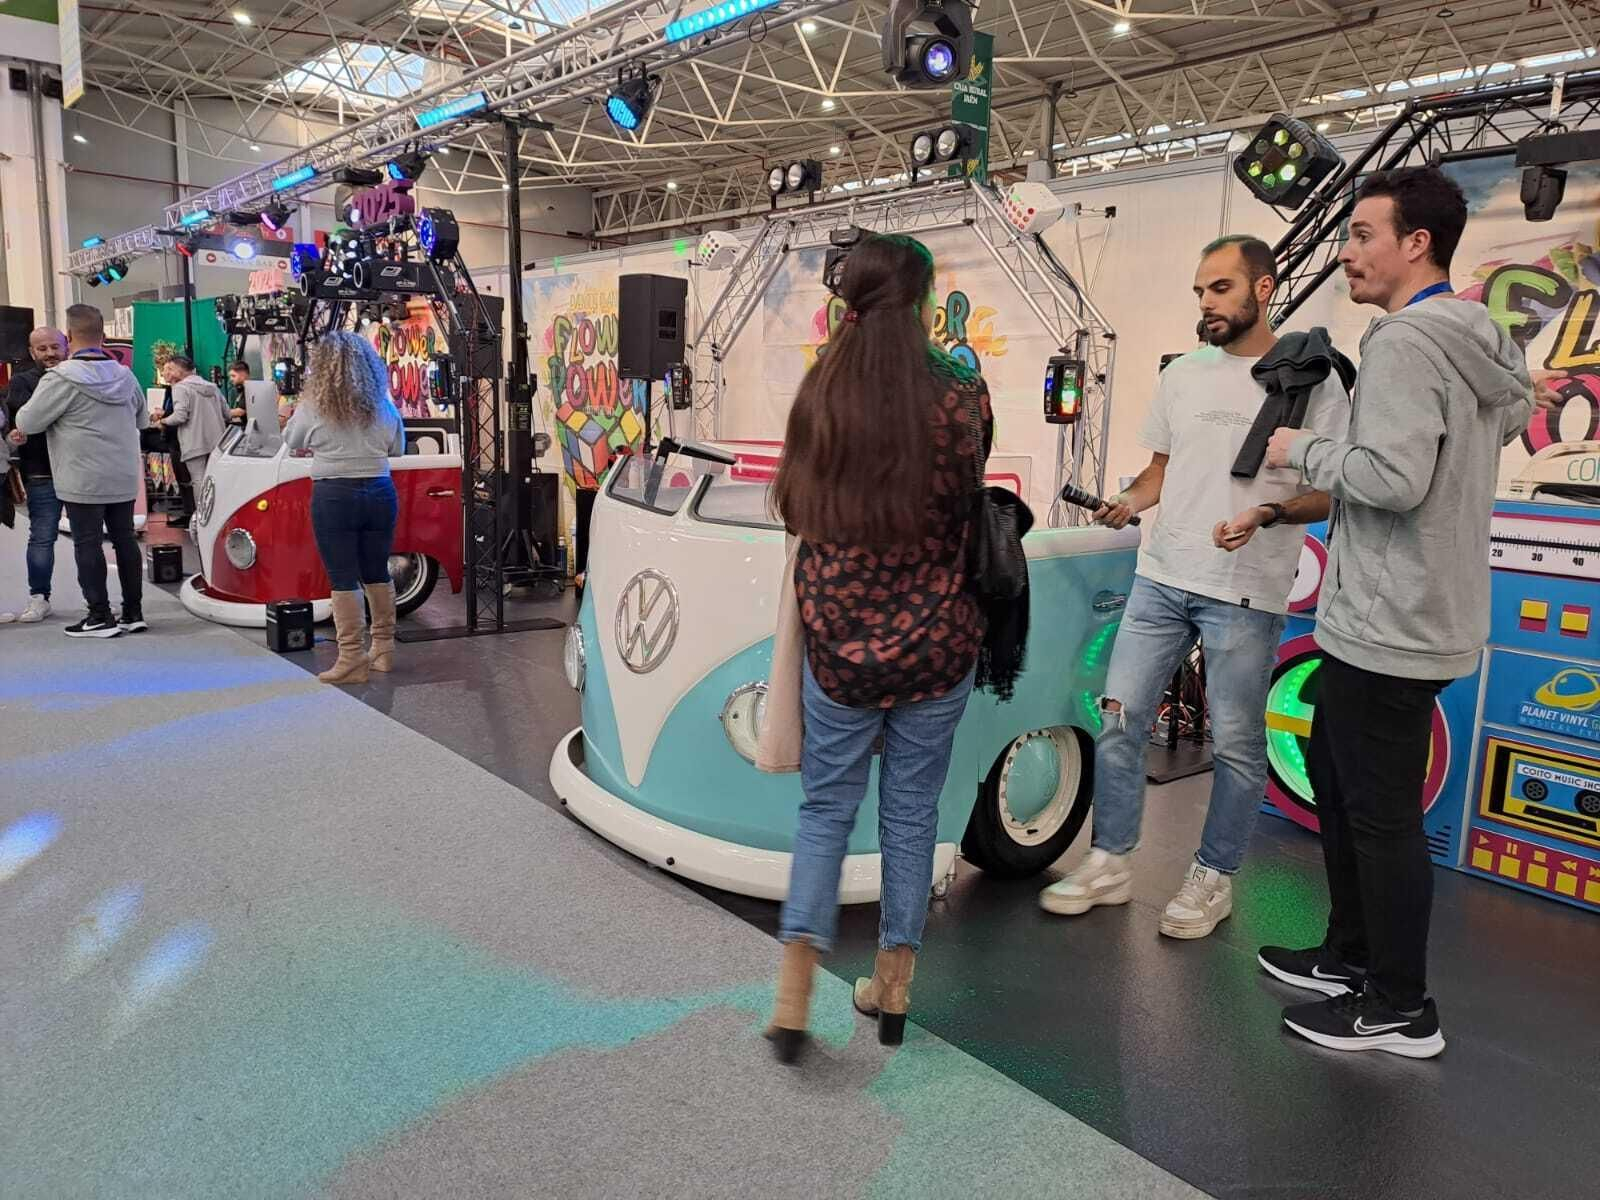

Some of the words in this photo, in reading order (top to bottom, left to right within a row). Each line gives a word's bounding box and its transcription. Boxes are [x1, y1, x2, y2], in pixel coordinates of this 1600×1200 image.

[1491, 548, 1503, 558] 20
[1531, 552, 1543, 562] 30
[1572, 557, 1584, 567] 40
[1521, 705, 1559, 721] PLANET
[1560, 713, 1588, 728] VINYL
[1522, 766, 1552, 779] COITO
[1554, 774, 1581, 786] MUSIC
